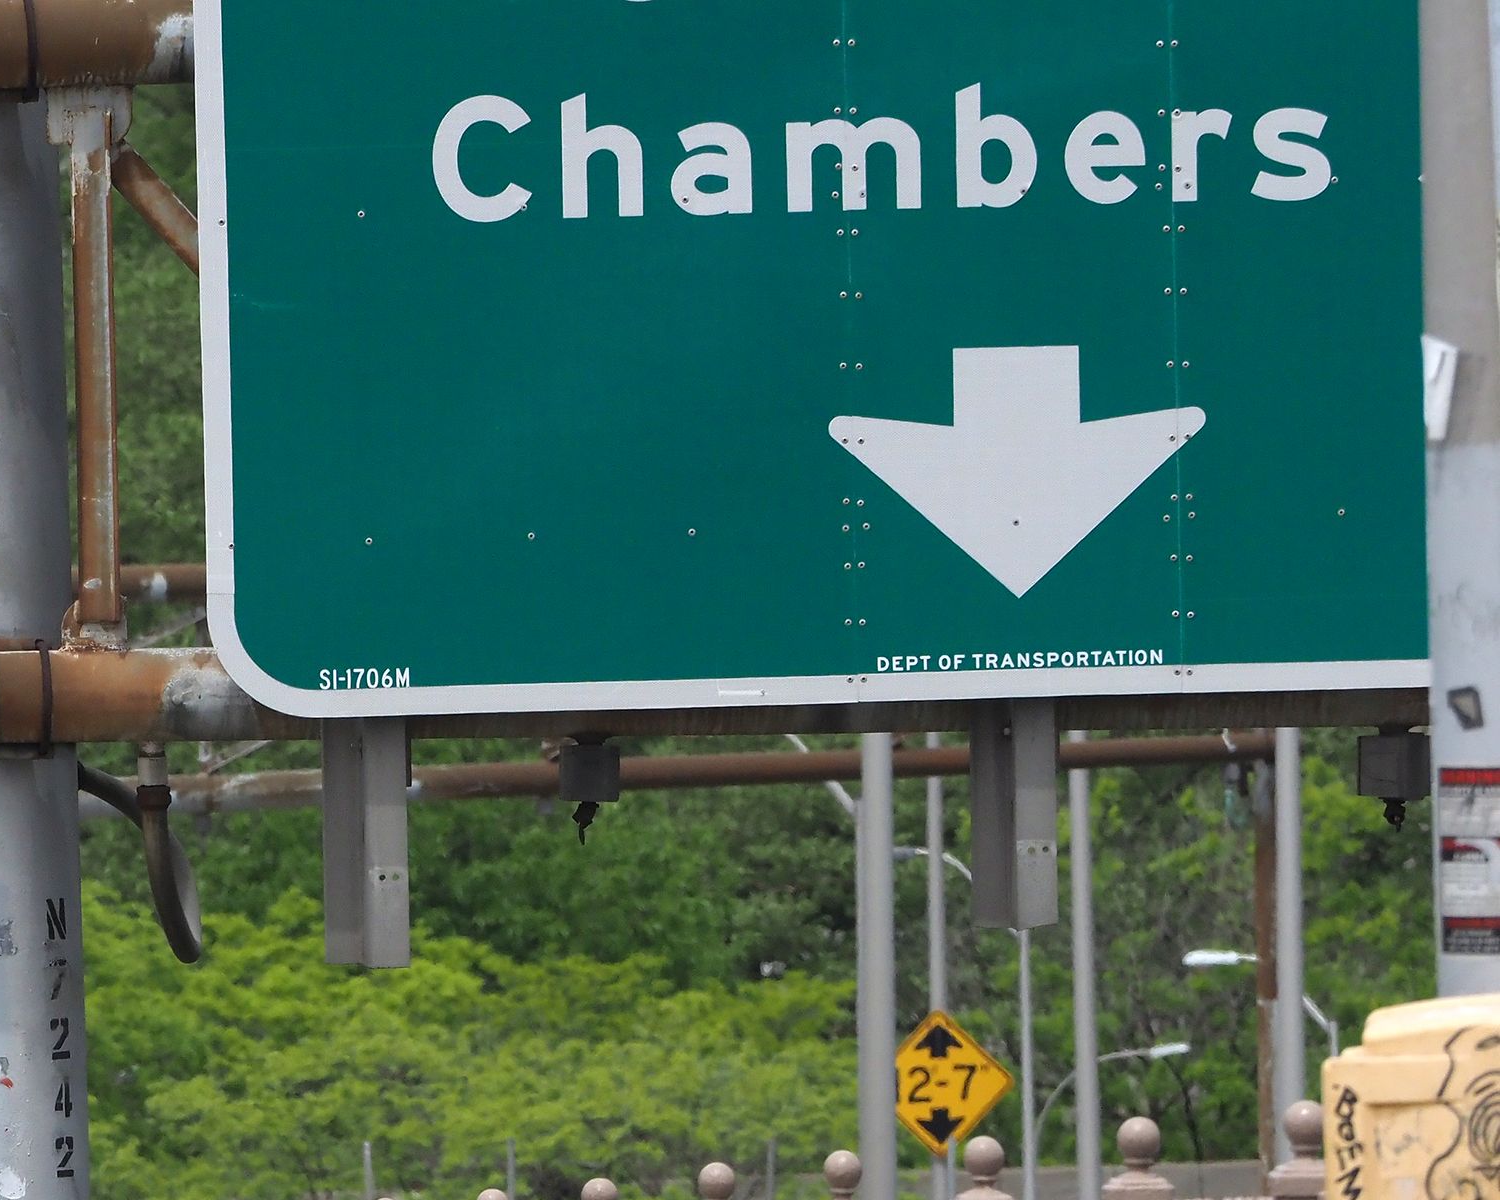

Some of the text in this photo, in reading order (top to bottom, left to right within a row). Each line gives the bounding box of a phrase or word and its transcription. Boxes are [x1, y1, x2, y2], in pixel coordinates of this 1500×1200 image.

[433, 82, 1332, 221] Chambers
[877, 649, 1164, 672] DEPT OF TRANSPORTATION
